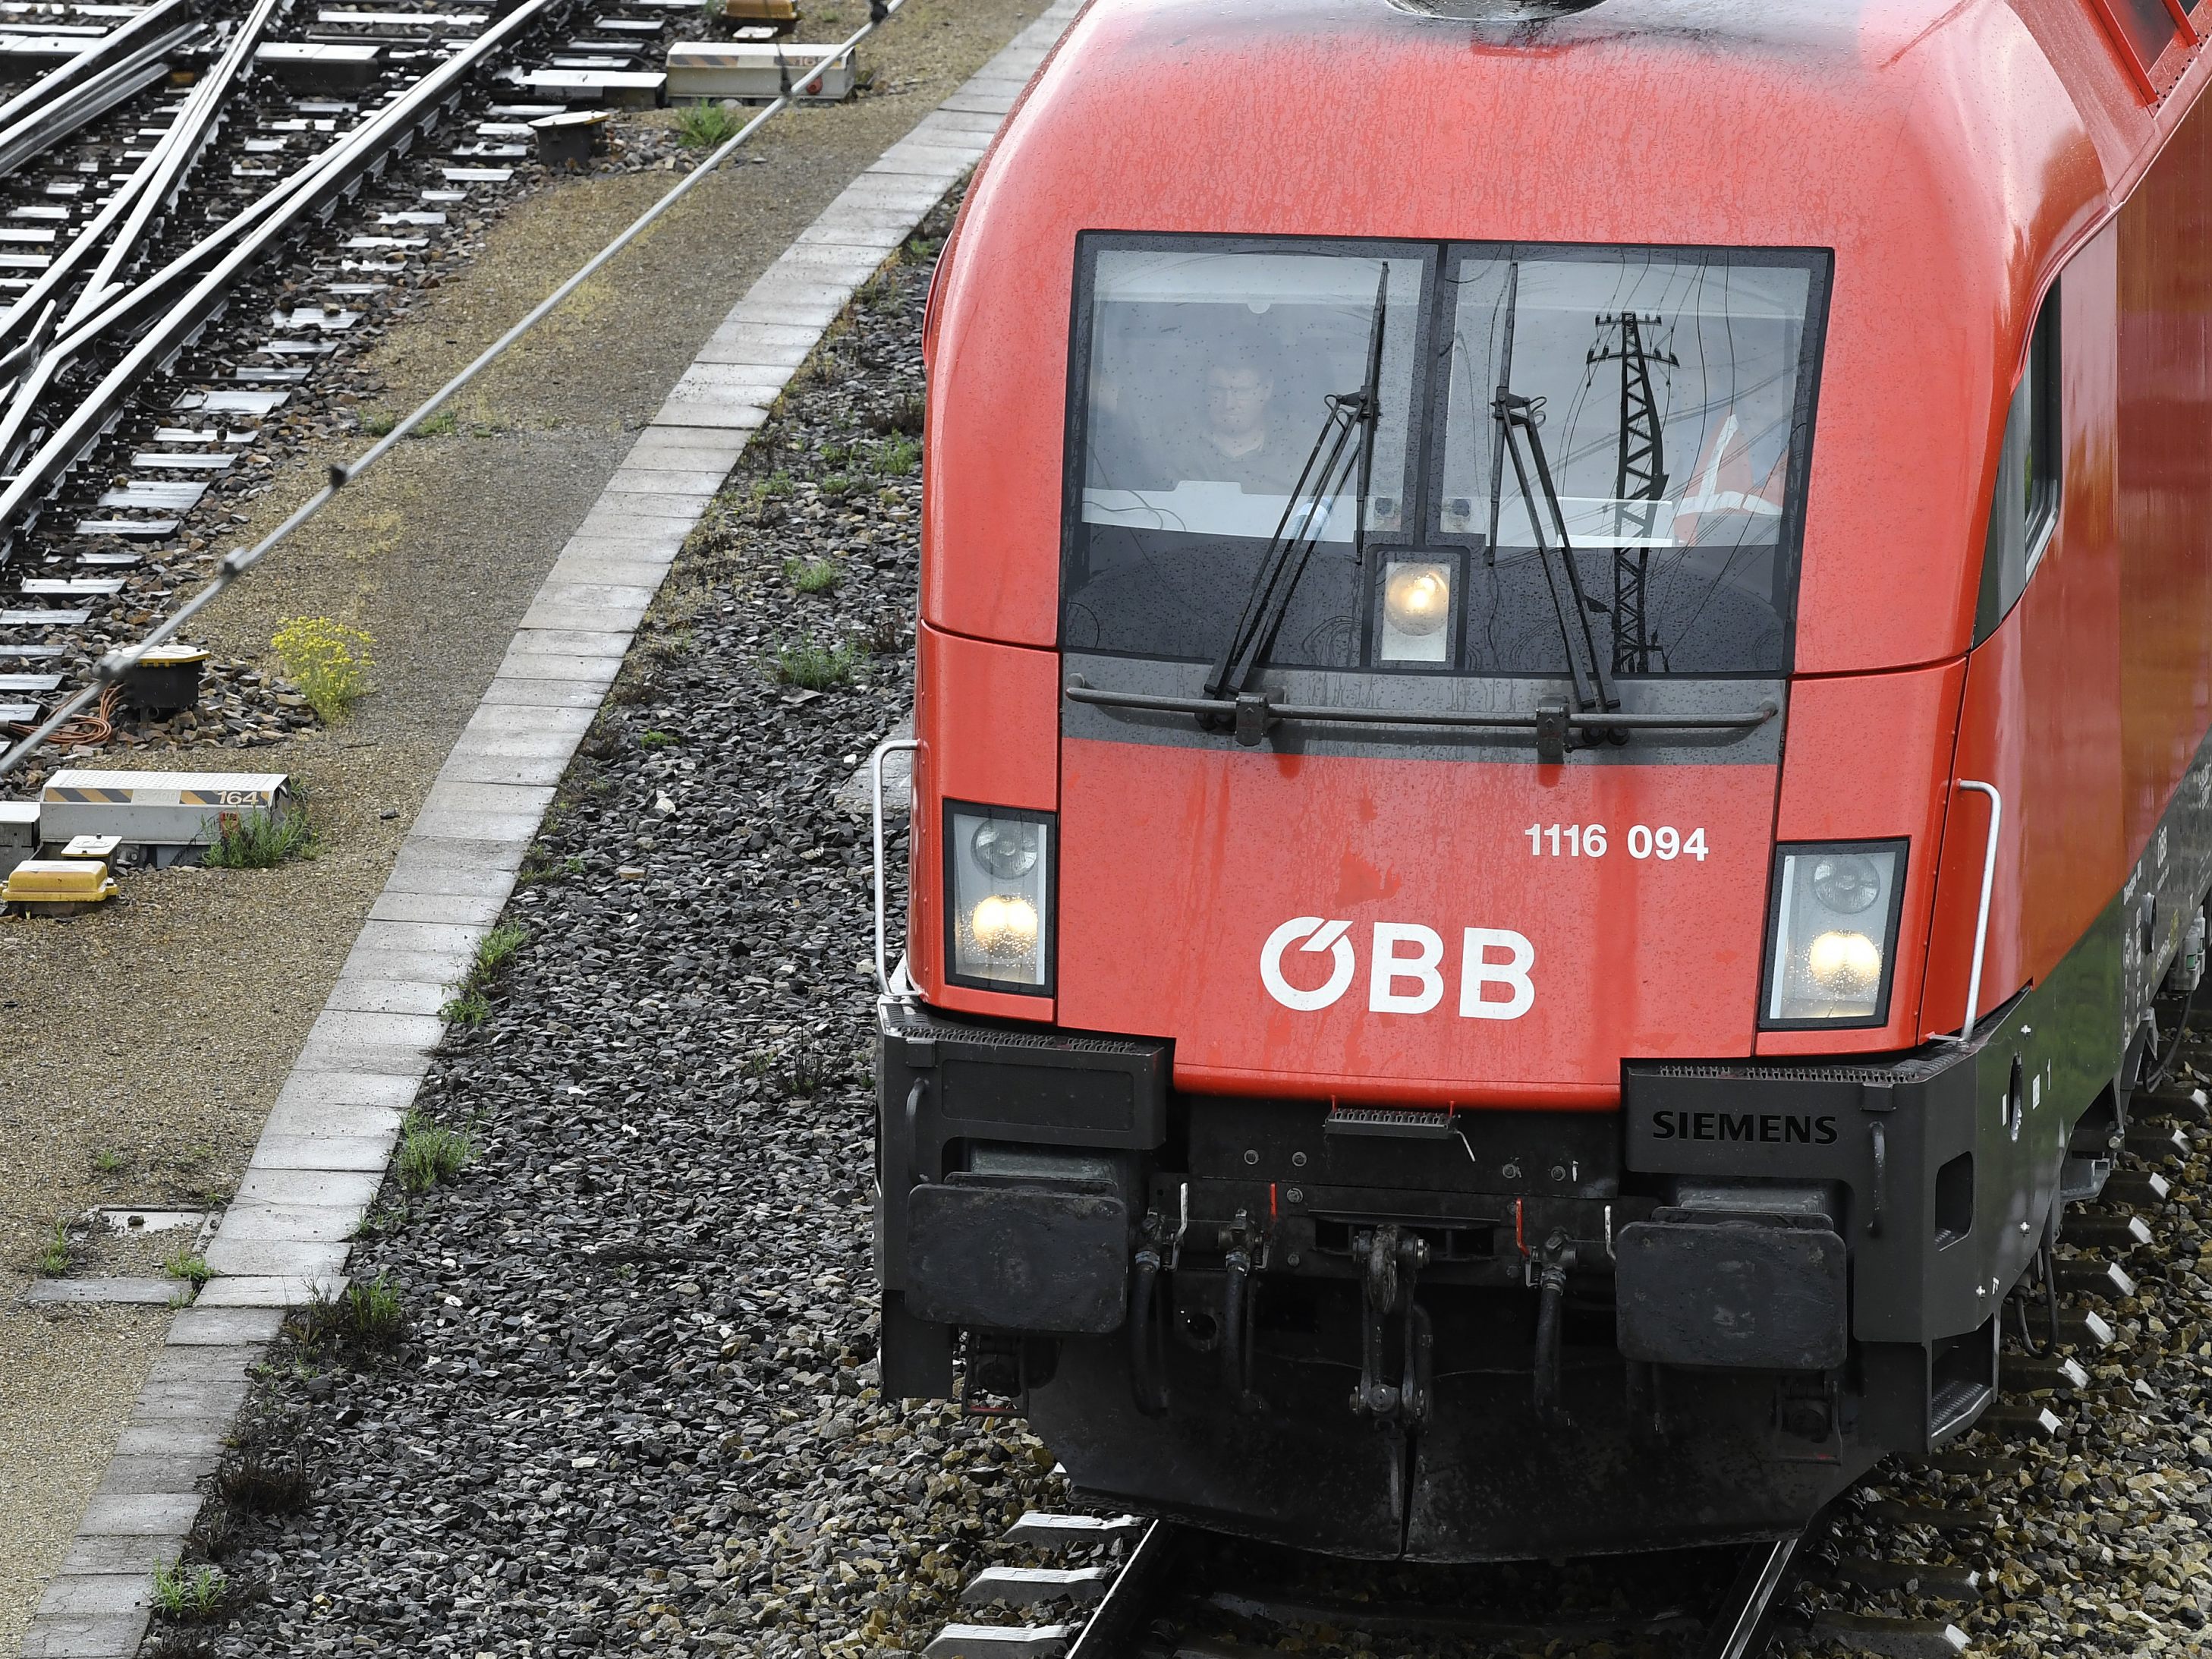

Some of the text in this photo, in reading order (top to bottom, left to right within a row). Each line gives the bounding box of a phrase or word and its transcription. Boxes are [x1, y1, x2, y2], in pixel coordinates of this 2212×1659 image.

[217, 791, 260, 805] 164
[1525, 823, 1708, 861] 1116 094
[1260, 916, 1535, 1020] ÖBB
[1653, 1110, 1838, 1145] SIEMENS
